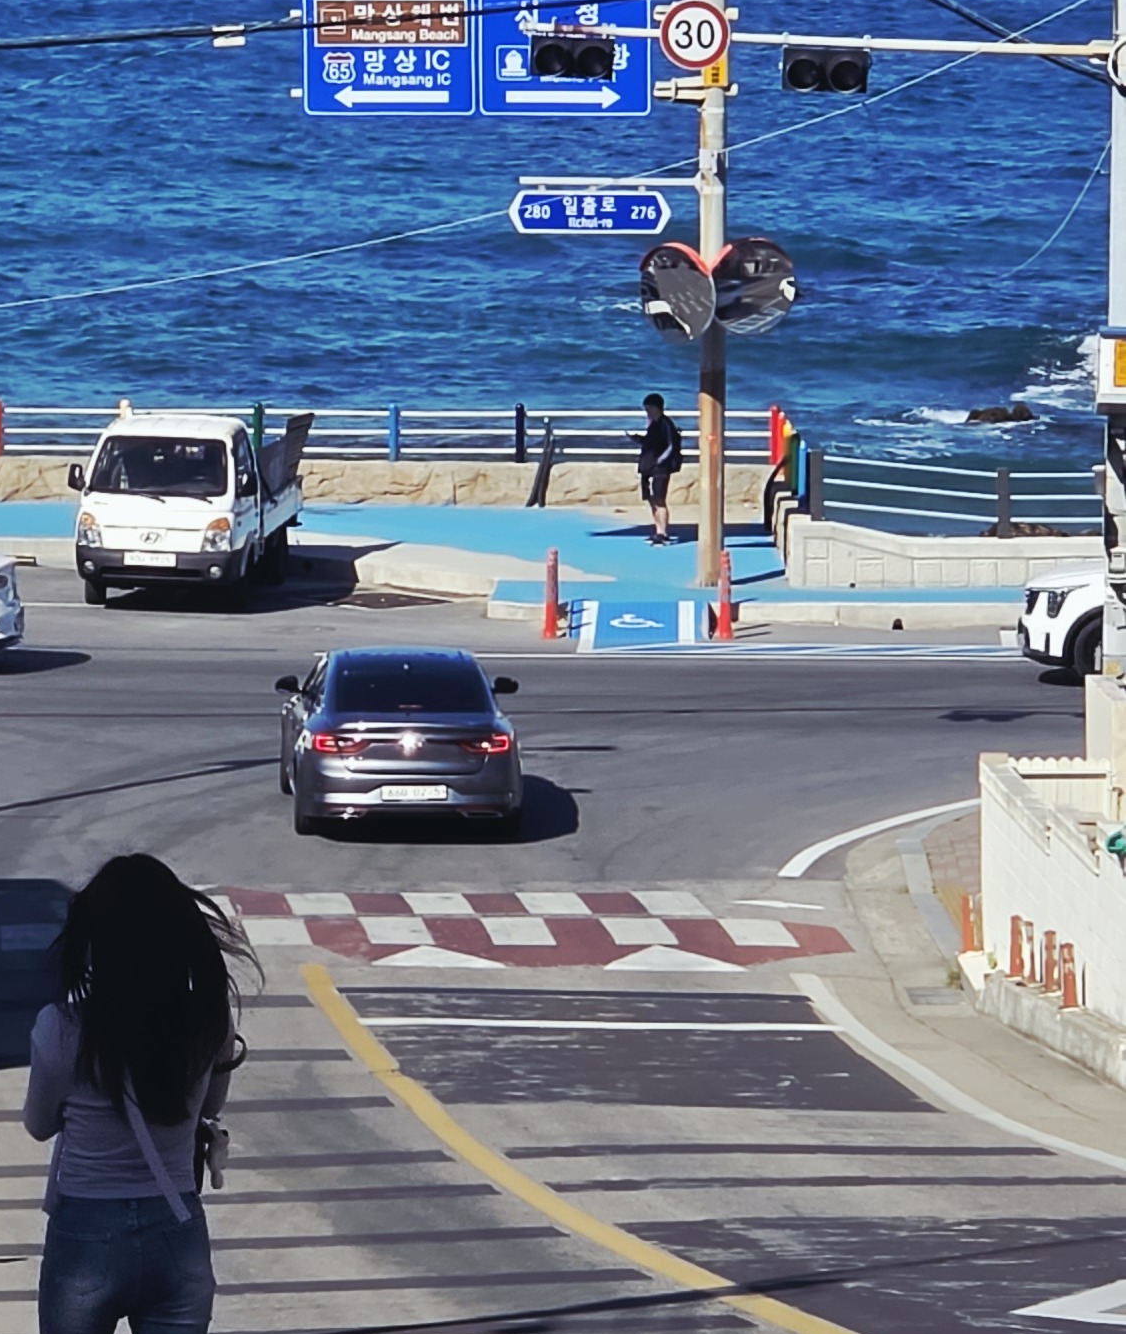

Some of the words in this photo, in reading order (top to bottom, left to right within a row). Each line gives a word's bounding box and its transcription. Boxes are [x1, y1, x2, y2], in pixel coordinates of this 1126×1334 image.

[351, 28, 417, 44] Mangsang
[419, 28, 460, 42] Beach
[674, 19, 716, 50] 30
[425, 49, 451, 71] IC
[328, 63, 351, 80] 65
[363, 73, 434, 89] Mangsang
[436, 73, 452, 86] IC
[524, 204, 551, 220] 280
[562, 196, 617, 216] 일출로
[630, 205, 657, 220] 276
